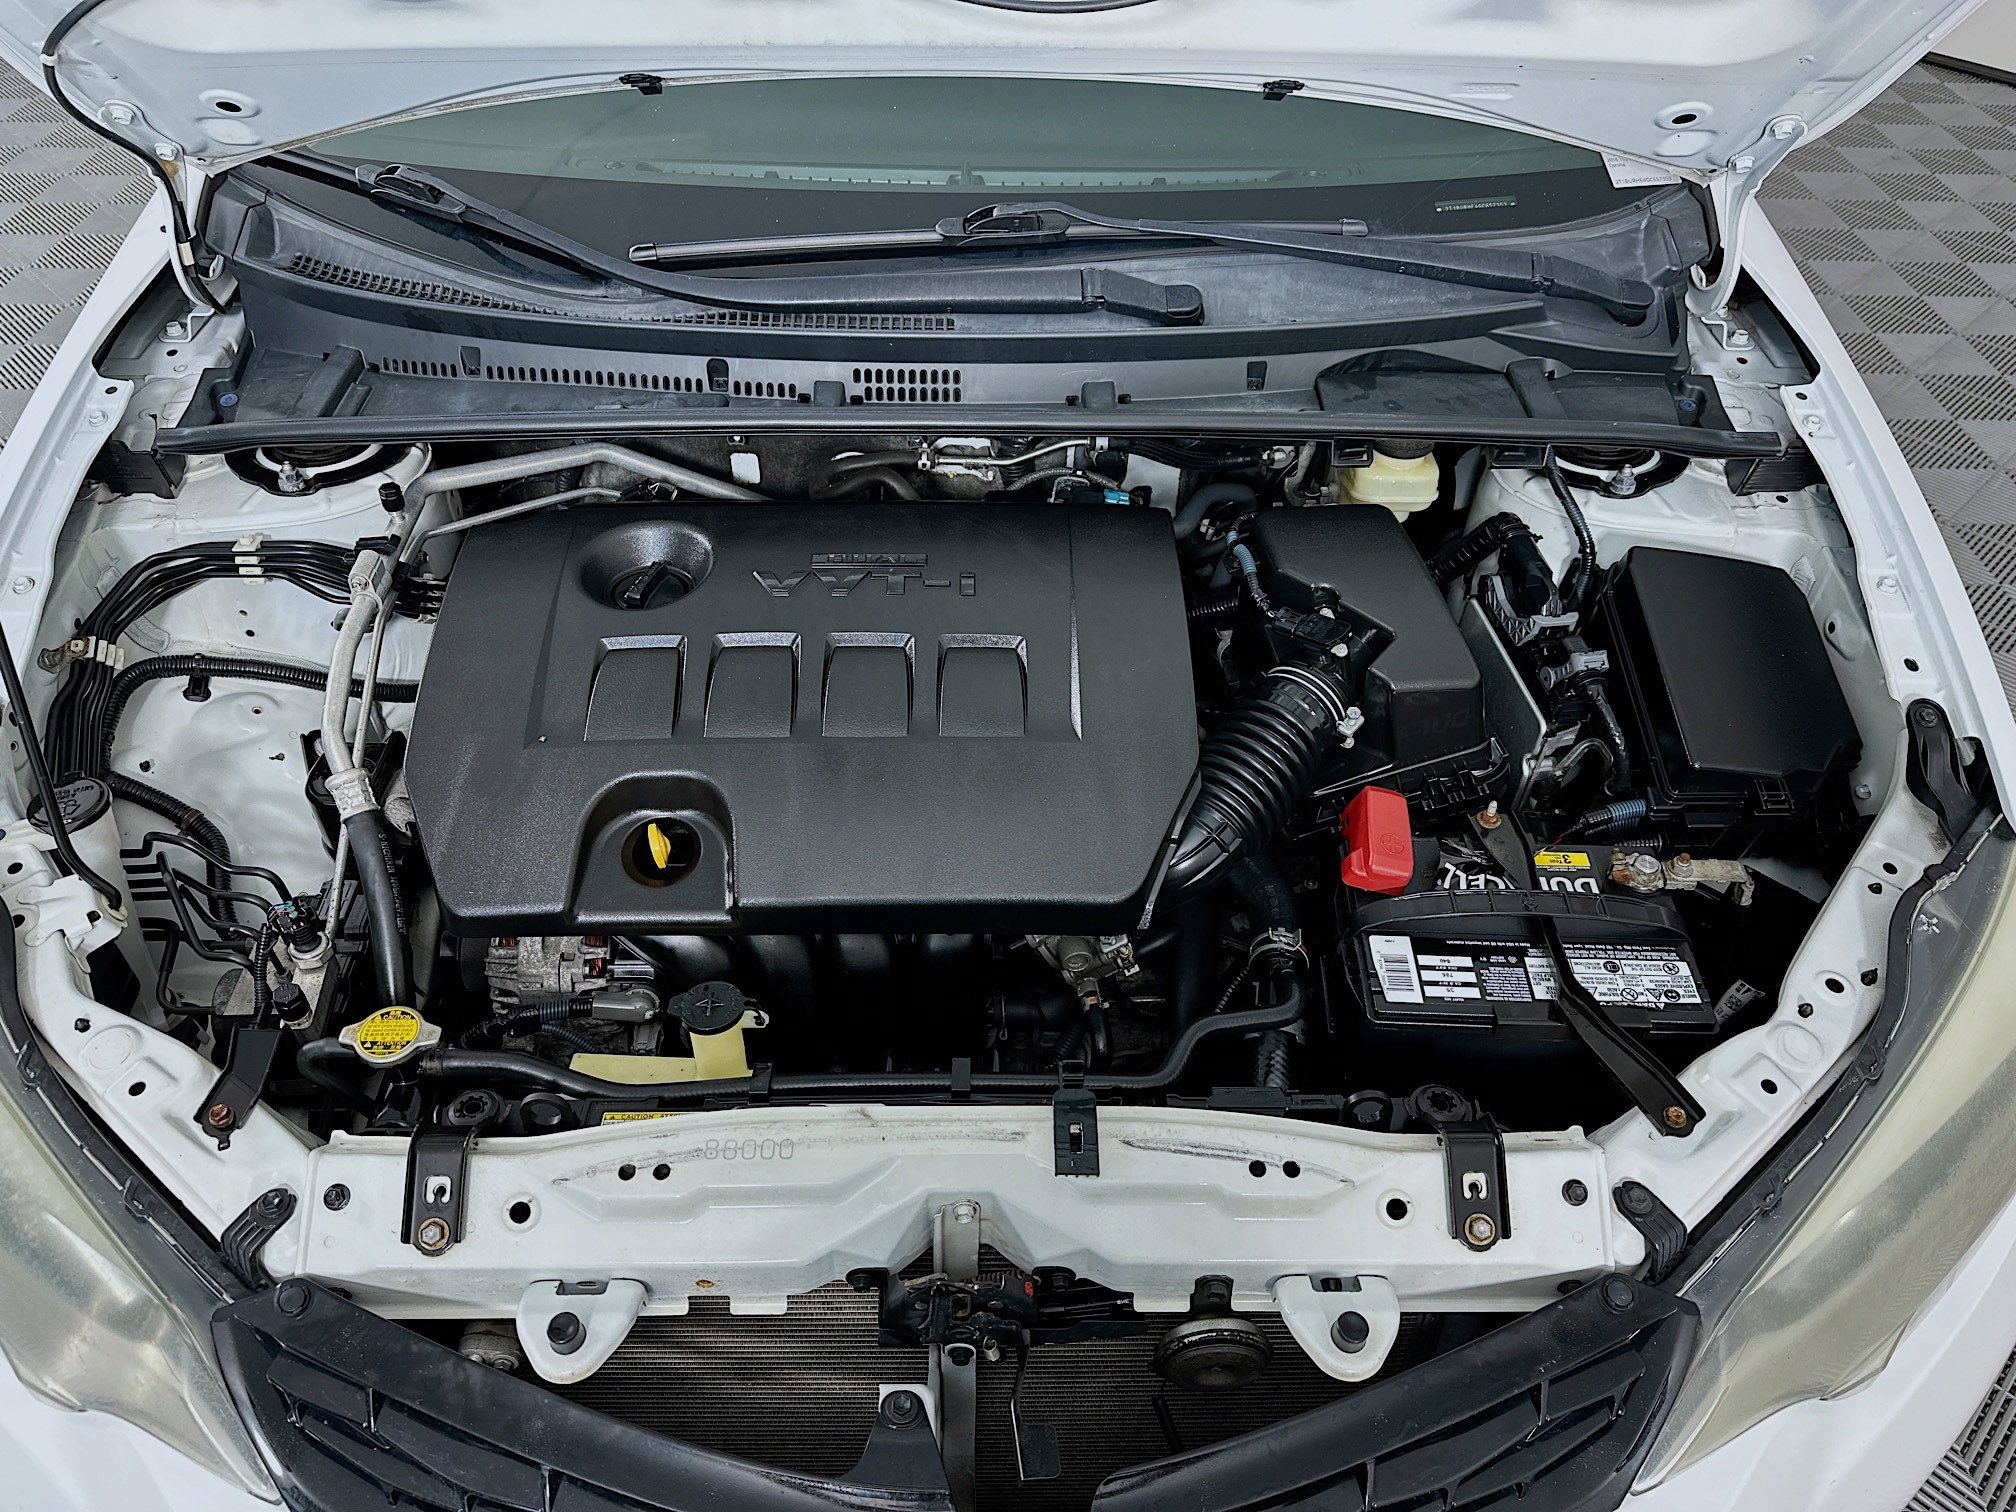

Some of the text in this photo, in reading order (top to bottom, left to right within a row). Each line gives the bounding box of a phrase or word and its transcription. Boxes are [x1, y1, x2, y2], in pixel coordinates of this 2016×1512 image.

[752, 570, 975, 597] VVT-i
[1562, 854, 1571, 864] 3
[704, 1139, 794, 1160] 88000
